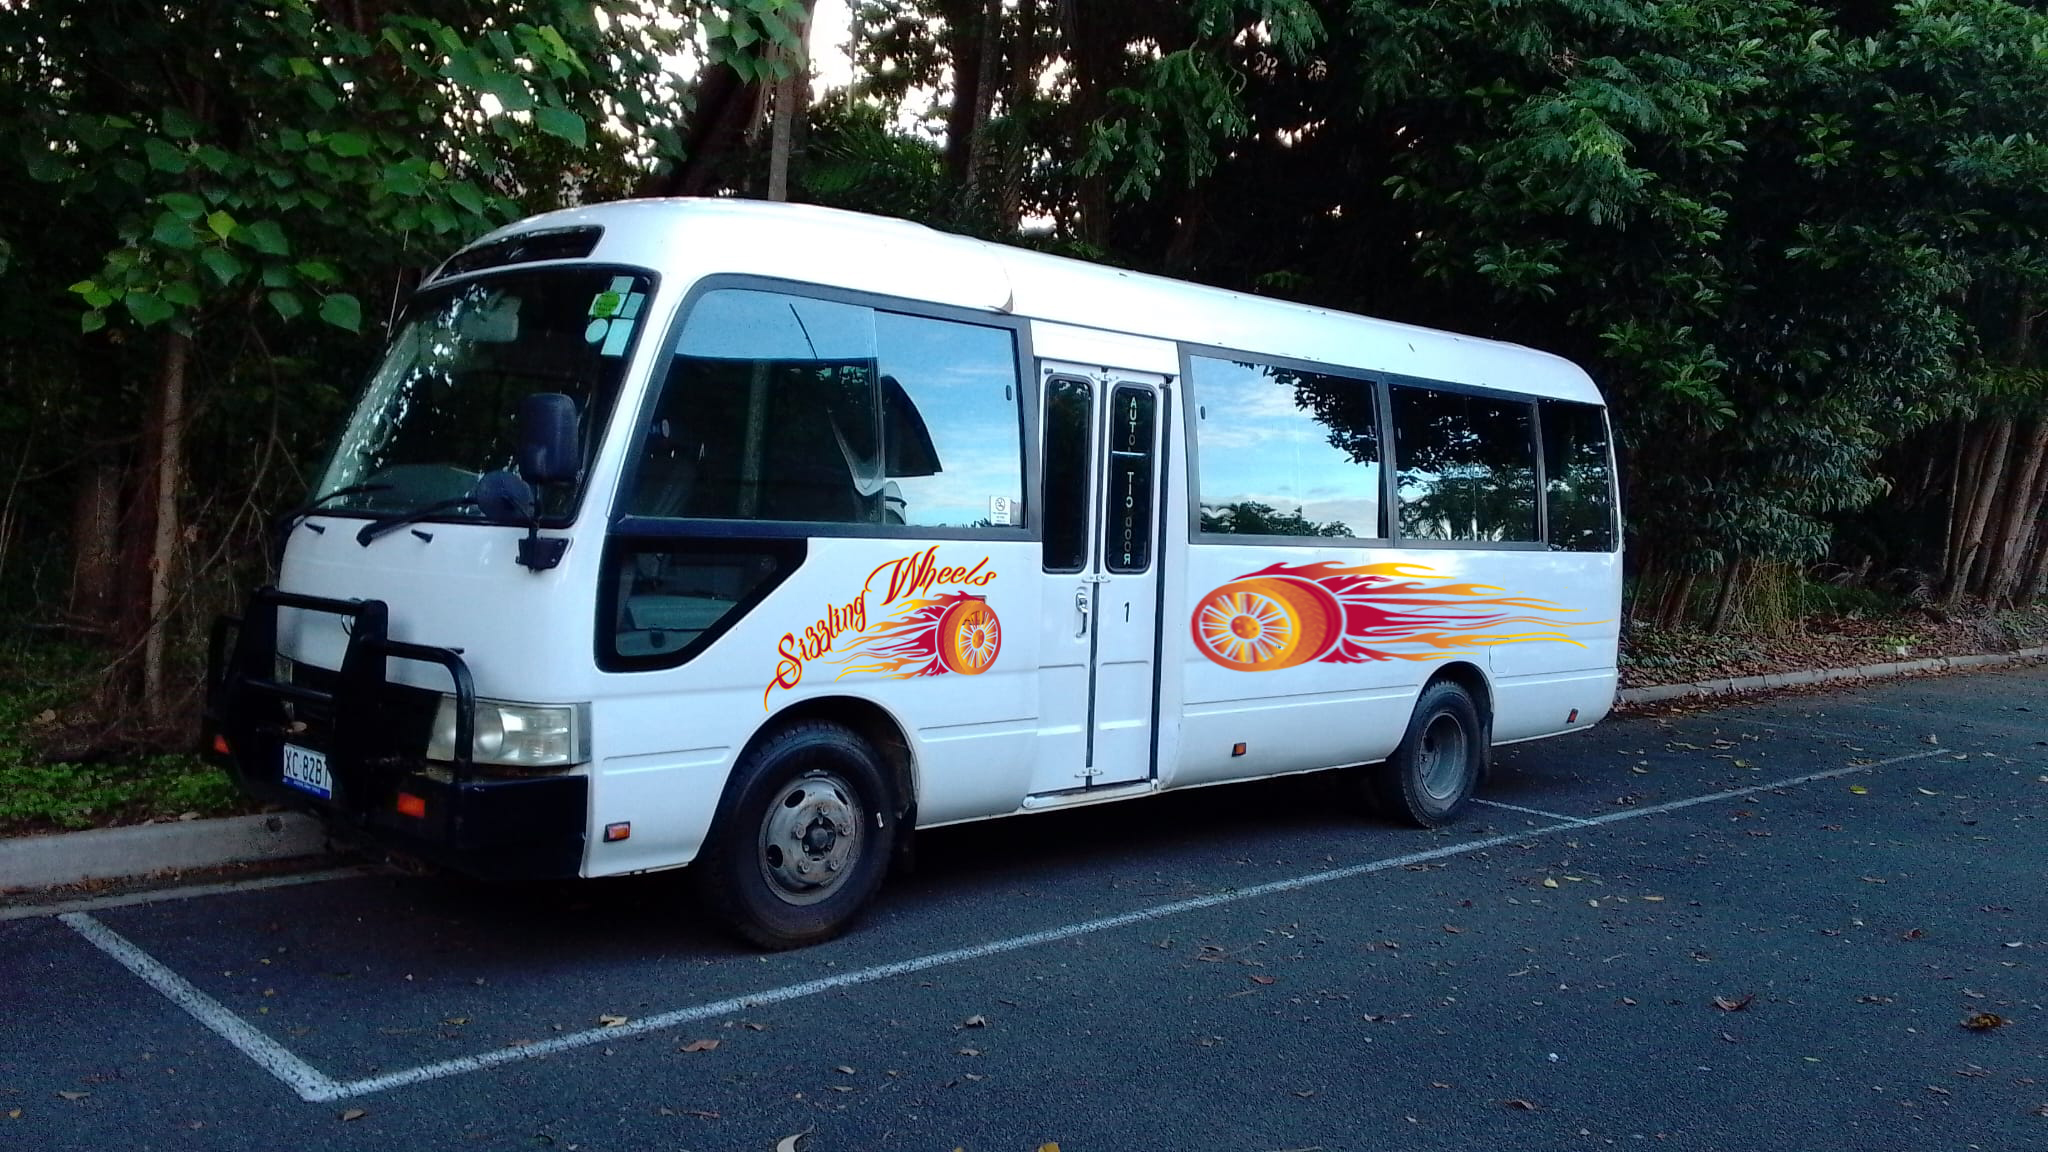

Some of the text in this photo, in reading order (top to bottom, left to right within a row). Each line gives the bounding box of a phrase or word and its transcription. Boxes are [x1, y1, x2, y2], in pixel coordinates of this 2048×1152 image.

[764, 545, 997, 712] Sizzling Wheels
[1124, 601, 1131, 623] 1
